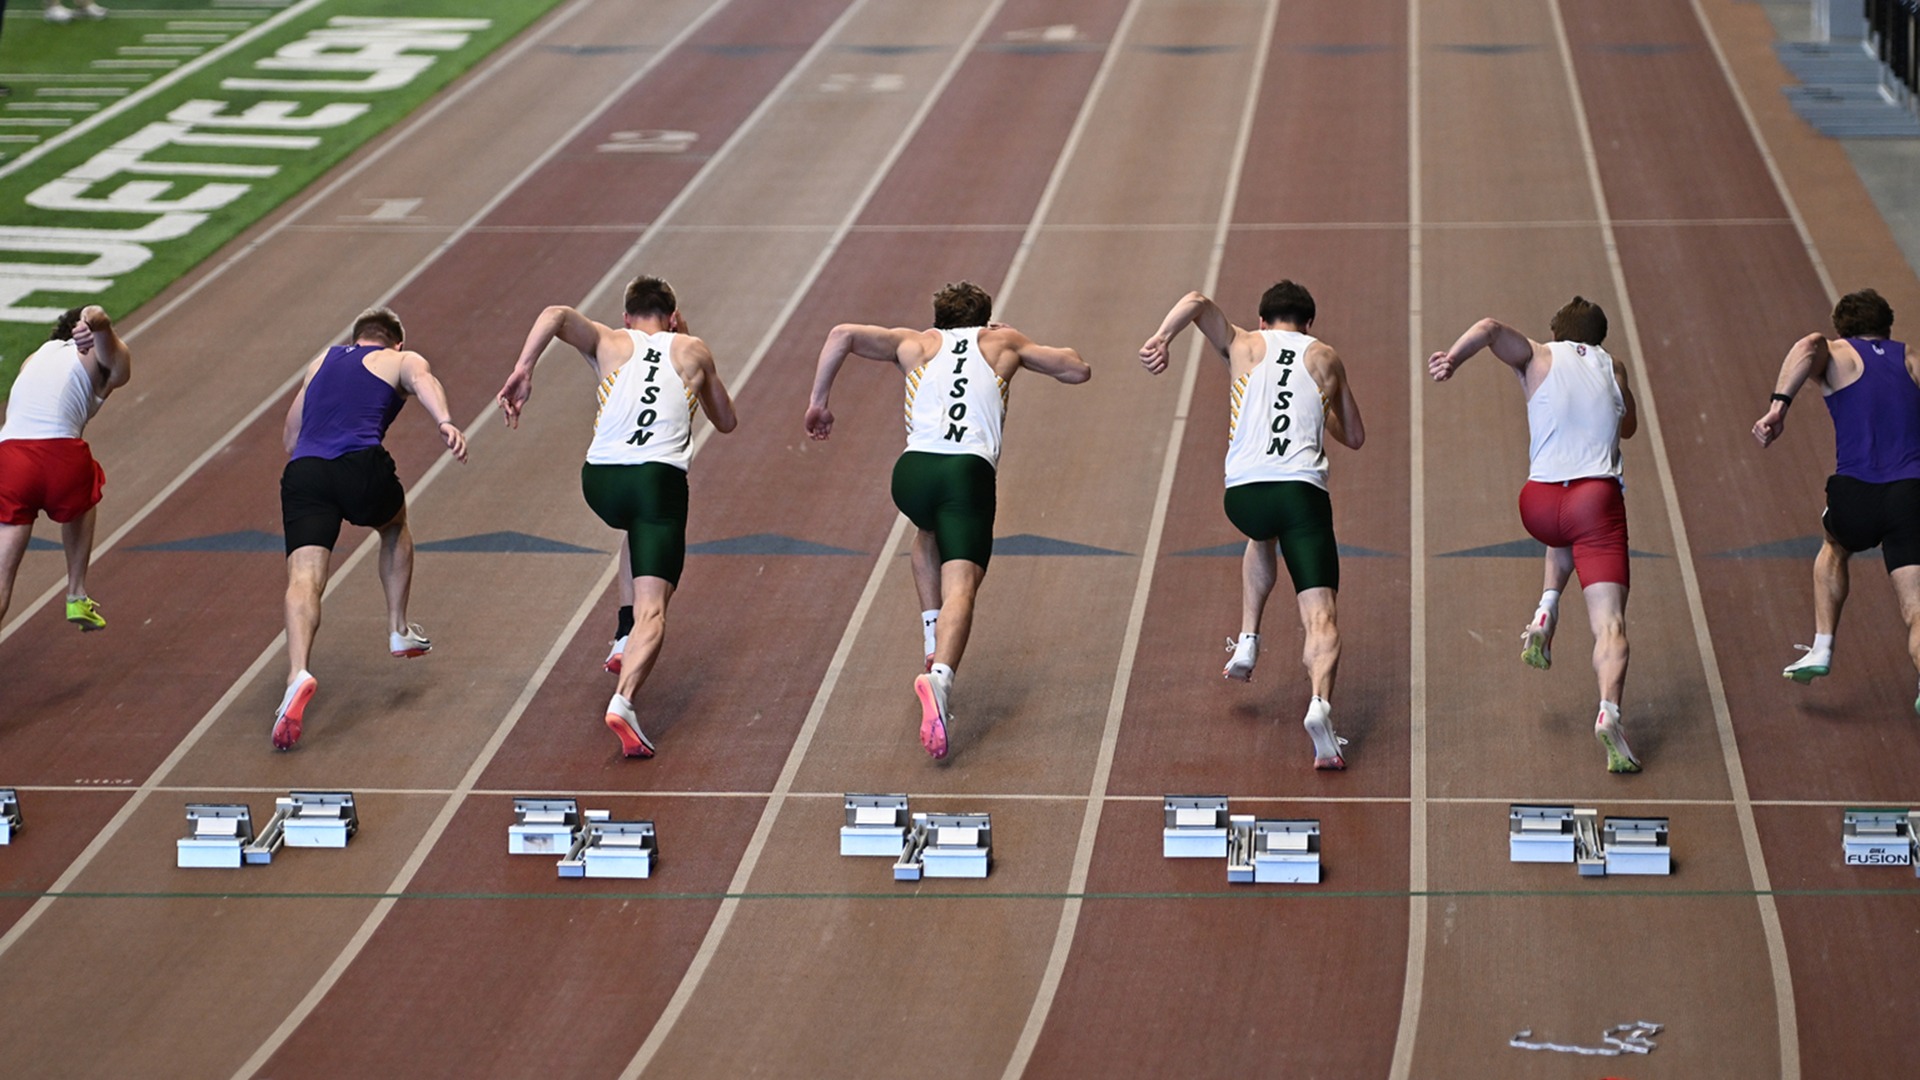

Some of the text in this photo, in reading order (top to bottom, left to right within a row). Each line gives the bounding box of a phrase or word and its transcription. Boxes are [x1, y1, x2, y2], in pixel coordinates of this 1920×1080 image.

[626, 347, 662, 446] BISON
[943, 338, 969, 443] BISON
[1265, 348, 1296, 456] BISON
[1847, 854, 1908, 864] FUSION
